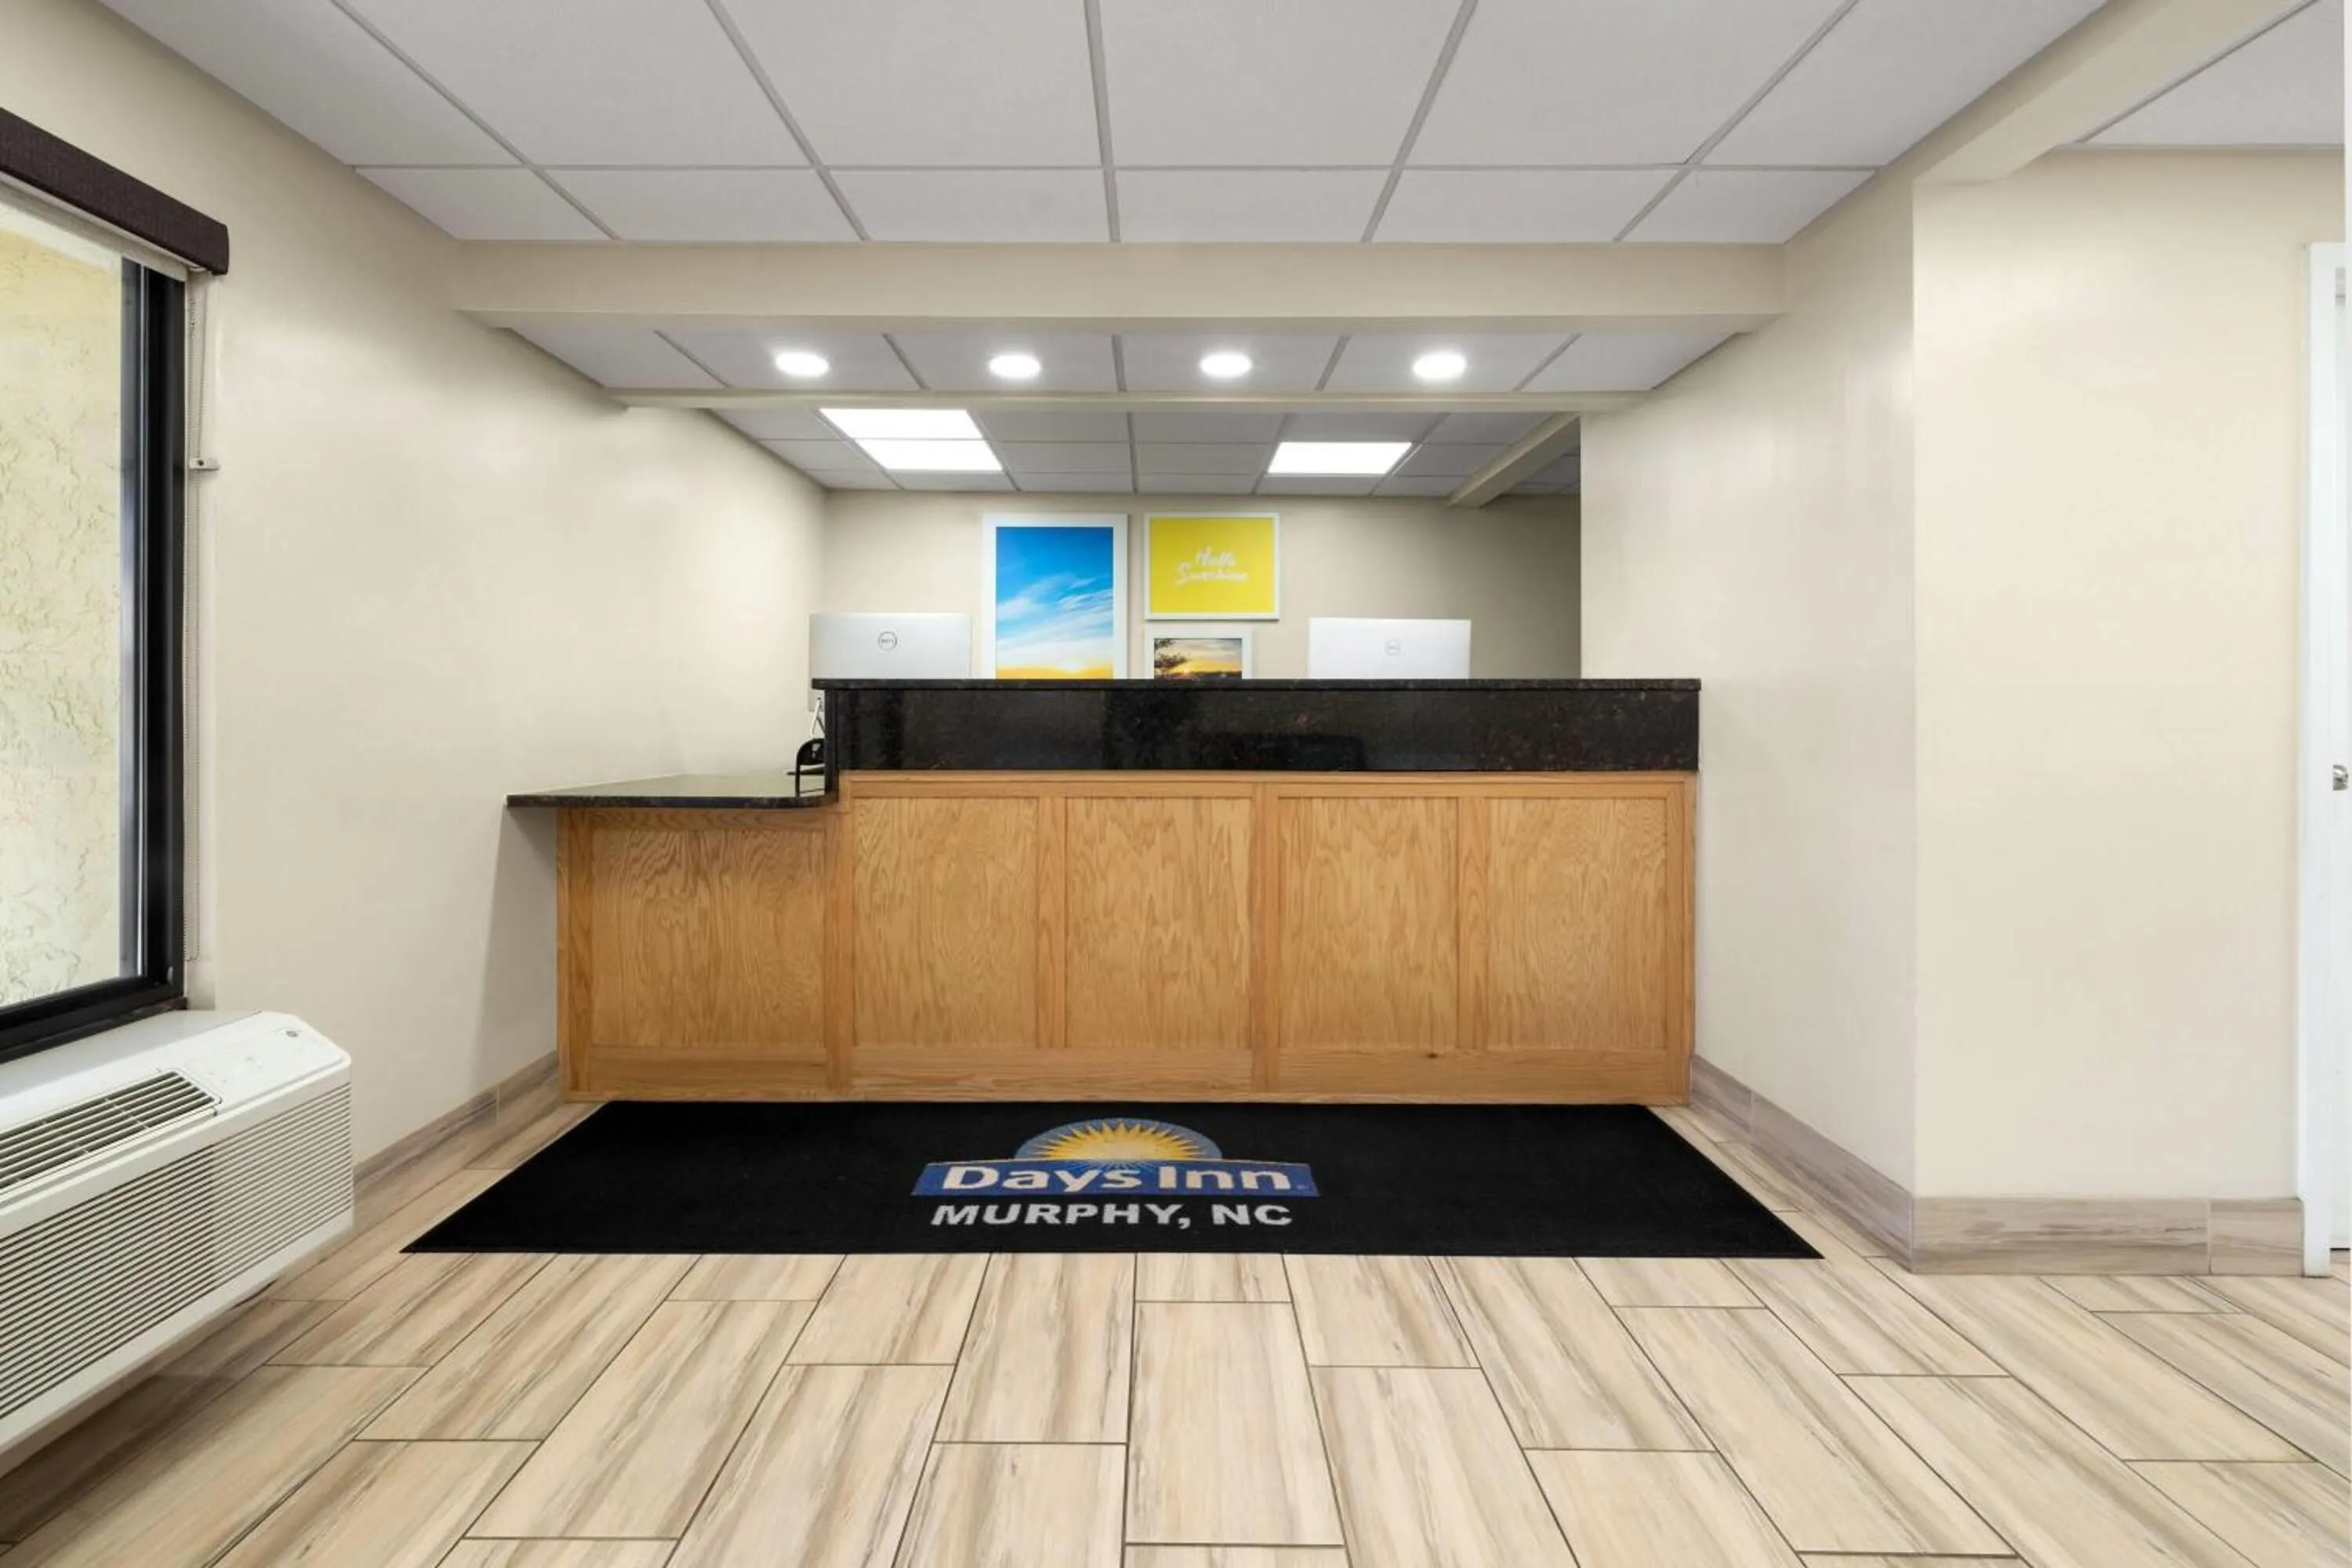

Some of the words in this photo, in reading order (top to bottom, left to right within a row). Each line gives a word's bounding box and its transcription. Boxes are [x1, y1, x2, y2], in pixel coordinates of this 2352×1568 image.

[942, 1166, 1142, 1192] Days
[1159, 1167, 1292, 1190] Inn
[931, 1203, 1191, 1229] MURPHY,
[1212, 1204, 1293, 1225] NC
